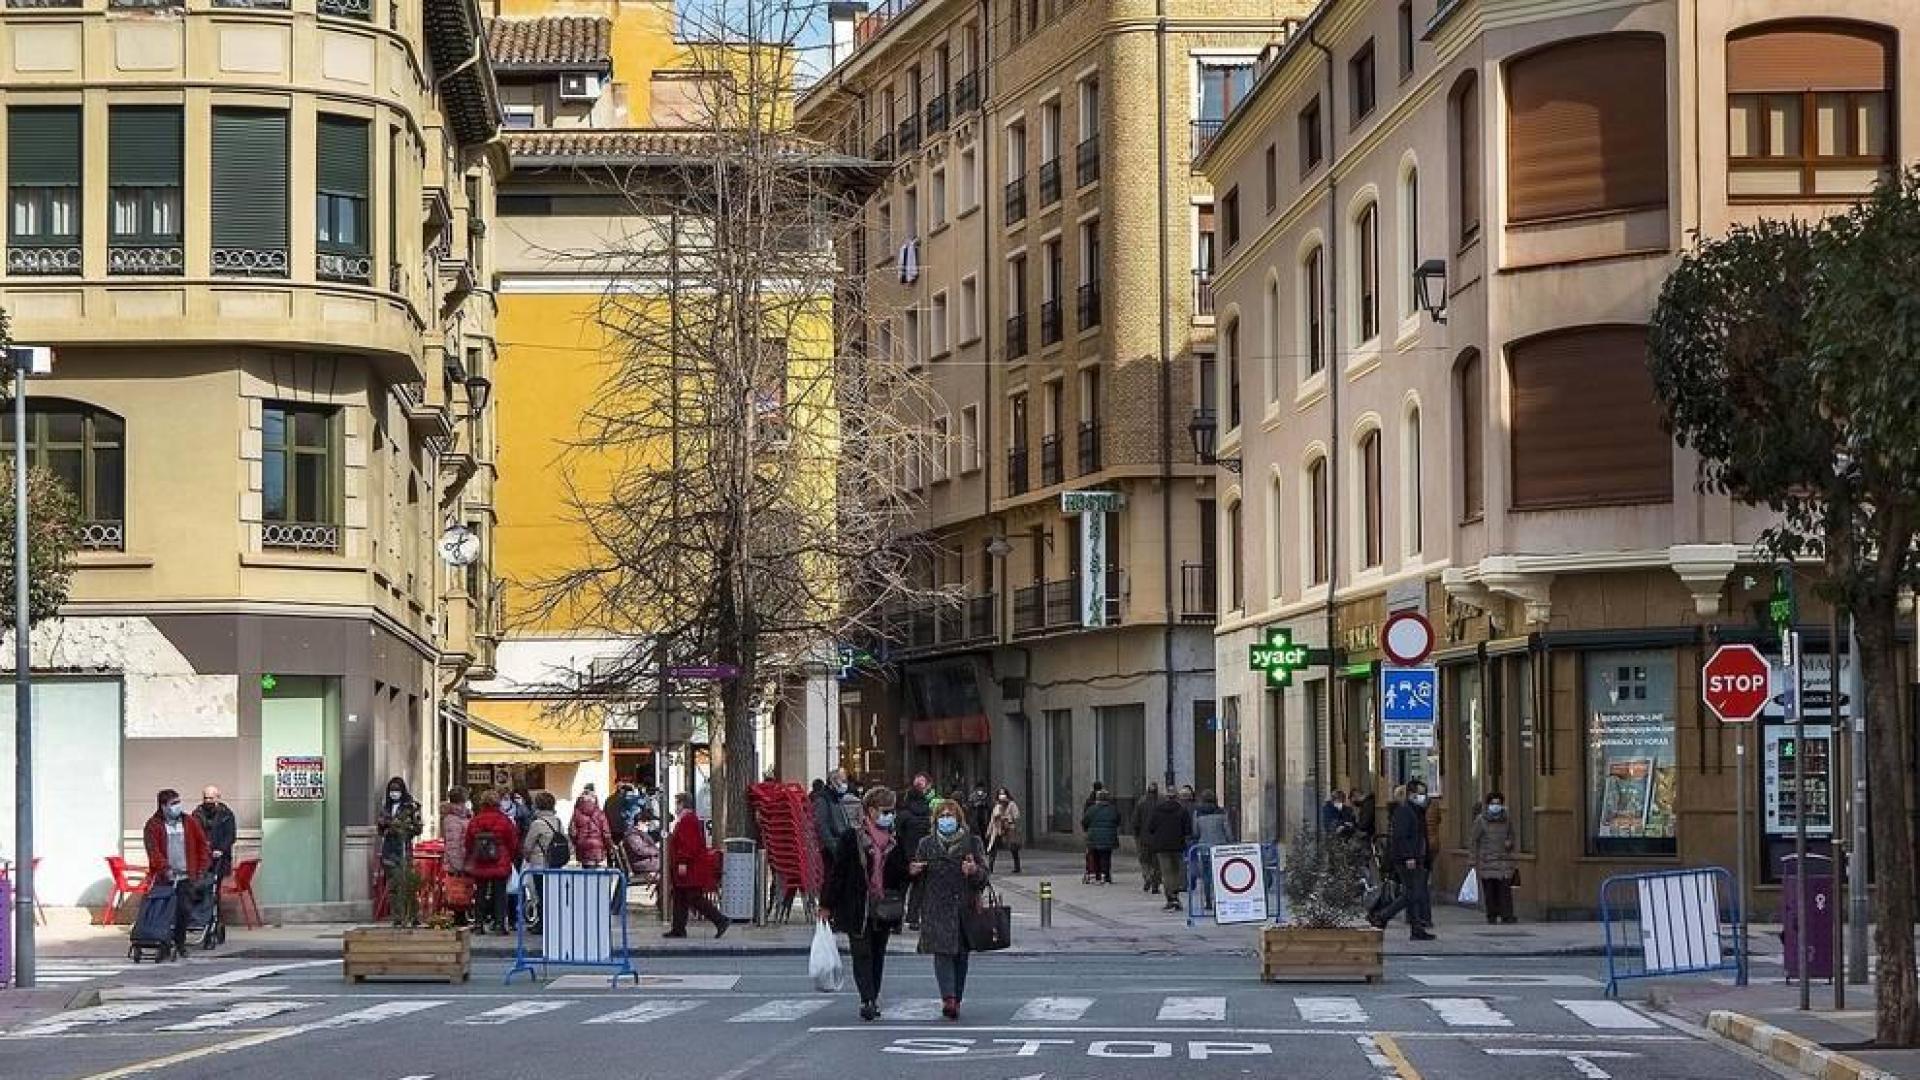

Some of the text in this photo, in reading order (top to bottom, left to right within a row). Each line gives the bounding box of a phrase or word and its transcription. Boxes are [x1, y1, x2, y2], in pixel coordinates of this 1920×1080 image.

[1709, 674, 1764, 693] STOP
[277, 787, 324, 798] ALQUILA
[881, 1038, 1273, 1060] STOP
